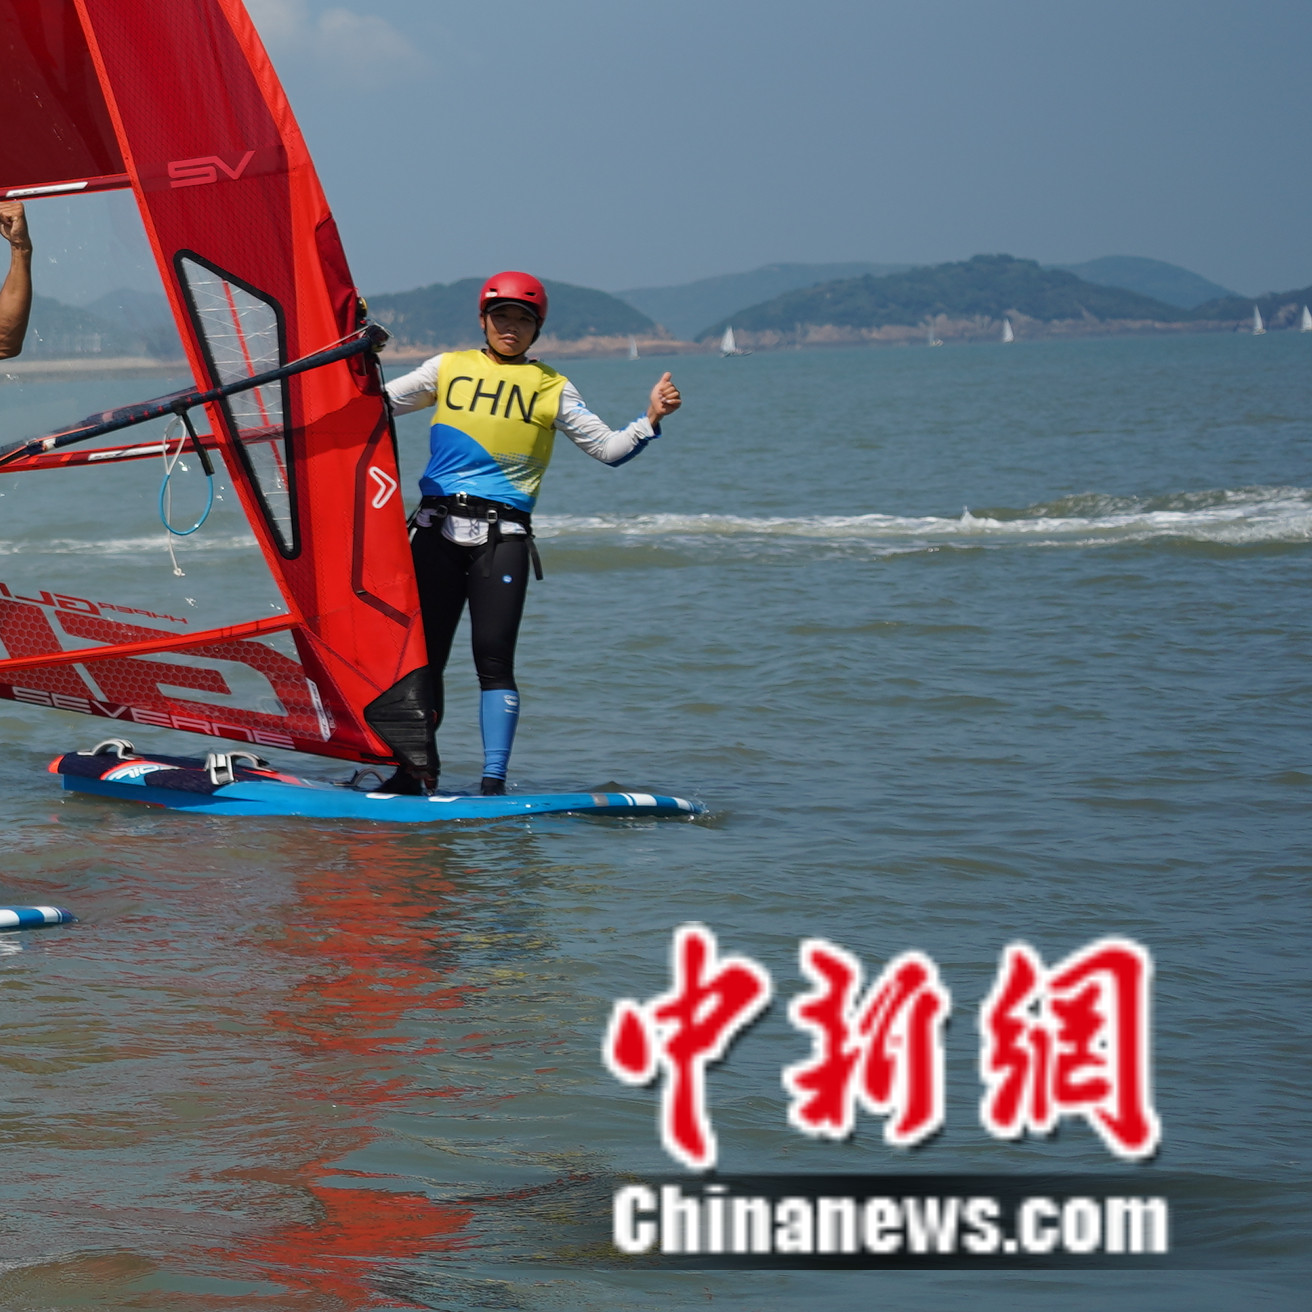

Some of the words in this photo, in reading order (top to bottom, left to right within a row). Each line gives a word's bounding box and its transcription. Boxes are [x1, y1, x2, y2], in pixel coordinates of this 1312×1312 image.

[167, 150, 256, 188] SV
[446, 376, 539, 424] CHN
[12, 685, 296, 750] SEVERNE
